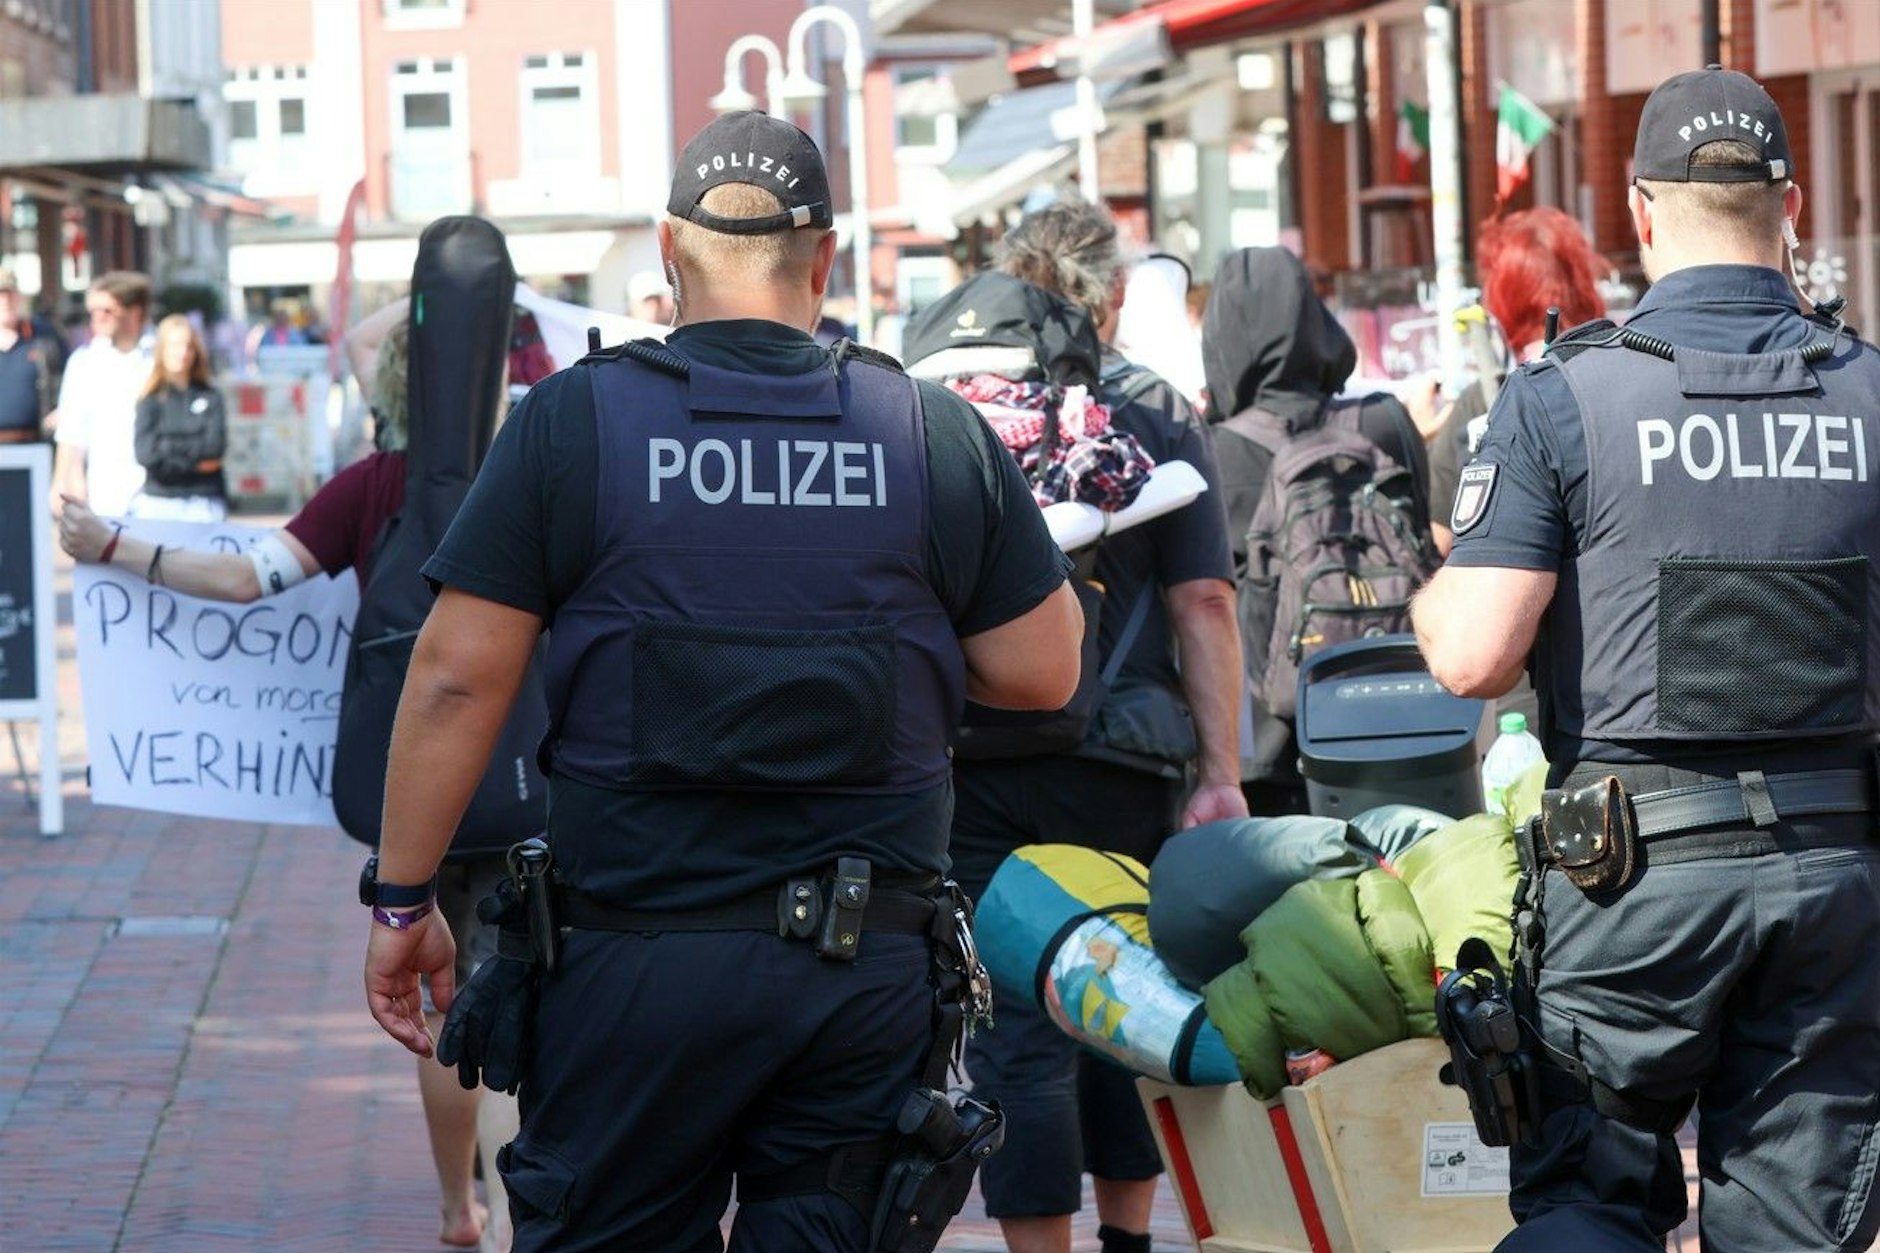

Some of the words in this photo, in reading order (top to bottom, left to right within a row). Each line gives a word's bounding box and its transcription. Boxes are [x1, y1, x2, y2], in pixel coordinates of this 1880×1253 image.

[1678, 109, 1773, 143] POLIZEI
[696, 152, 799, 189] POLIZEI
[1636, 412, 1868, 486] POLIZEI
[648, 437, 888, 507] POLIZEI
[172, 682, 240, 705] von
